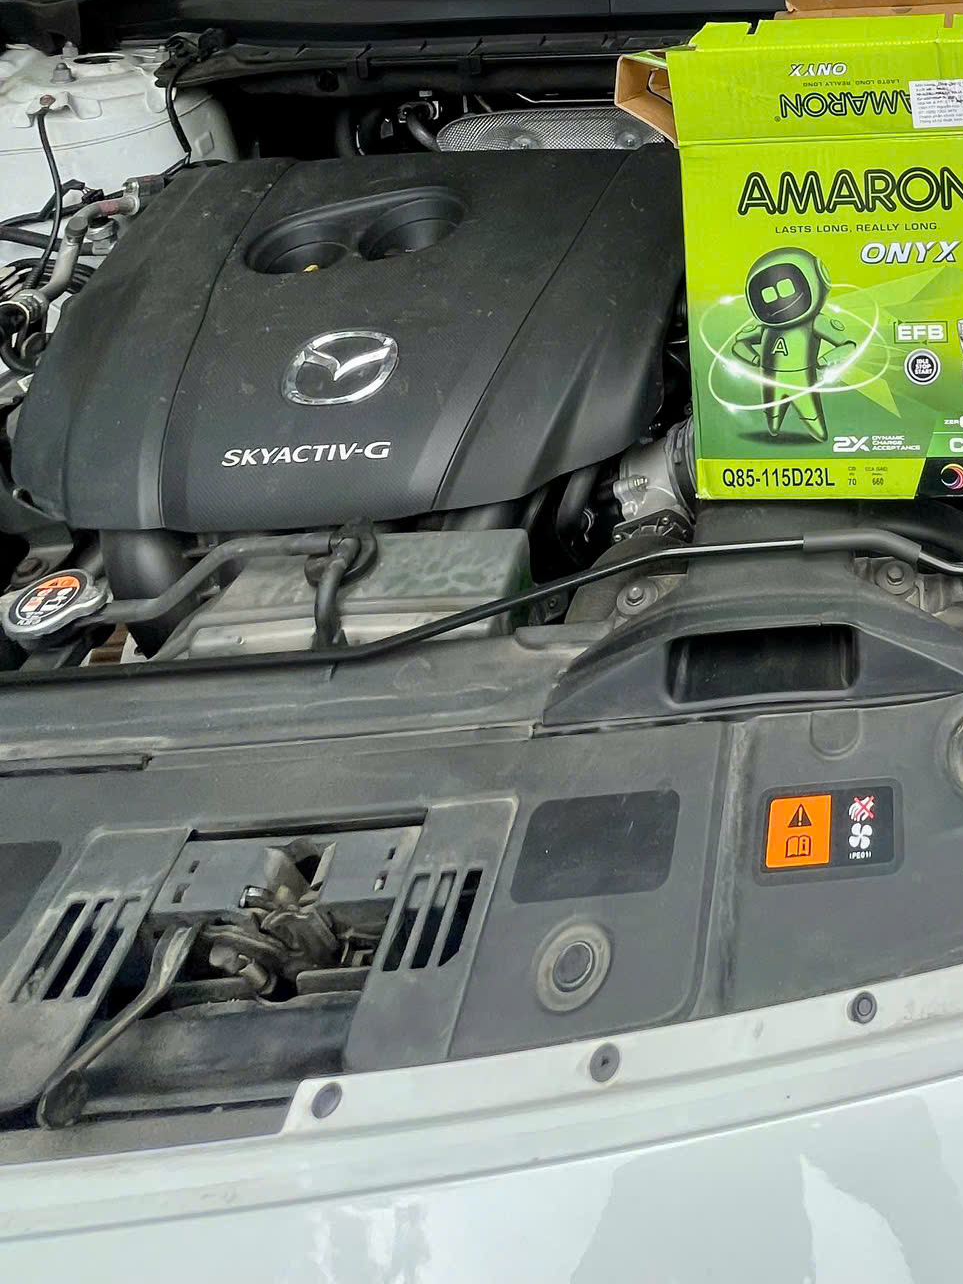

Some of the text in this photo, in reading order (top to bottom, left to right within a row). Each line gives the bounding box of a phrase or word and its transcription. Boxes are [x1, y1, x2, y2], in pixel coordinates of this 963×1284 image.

[788, 62, 847, 76] ONYX
[775, 222, 941, 234] LASTS LONG, REALLY LONG.
[860, 240, 962, 264] ONYX
[897, 324, 945, 341] EFB
[833, 436, 870, 453] 2X
[221, 440, 392, 467] SKYACTIV-G
[722, 467, 835, 488] Q85-115D23L
